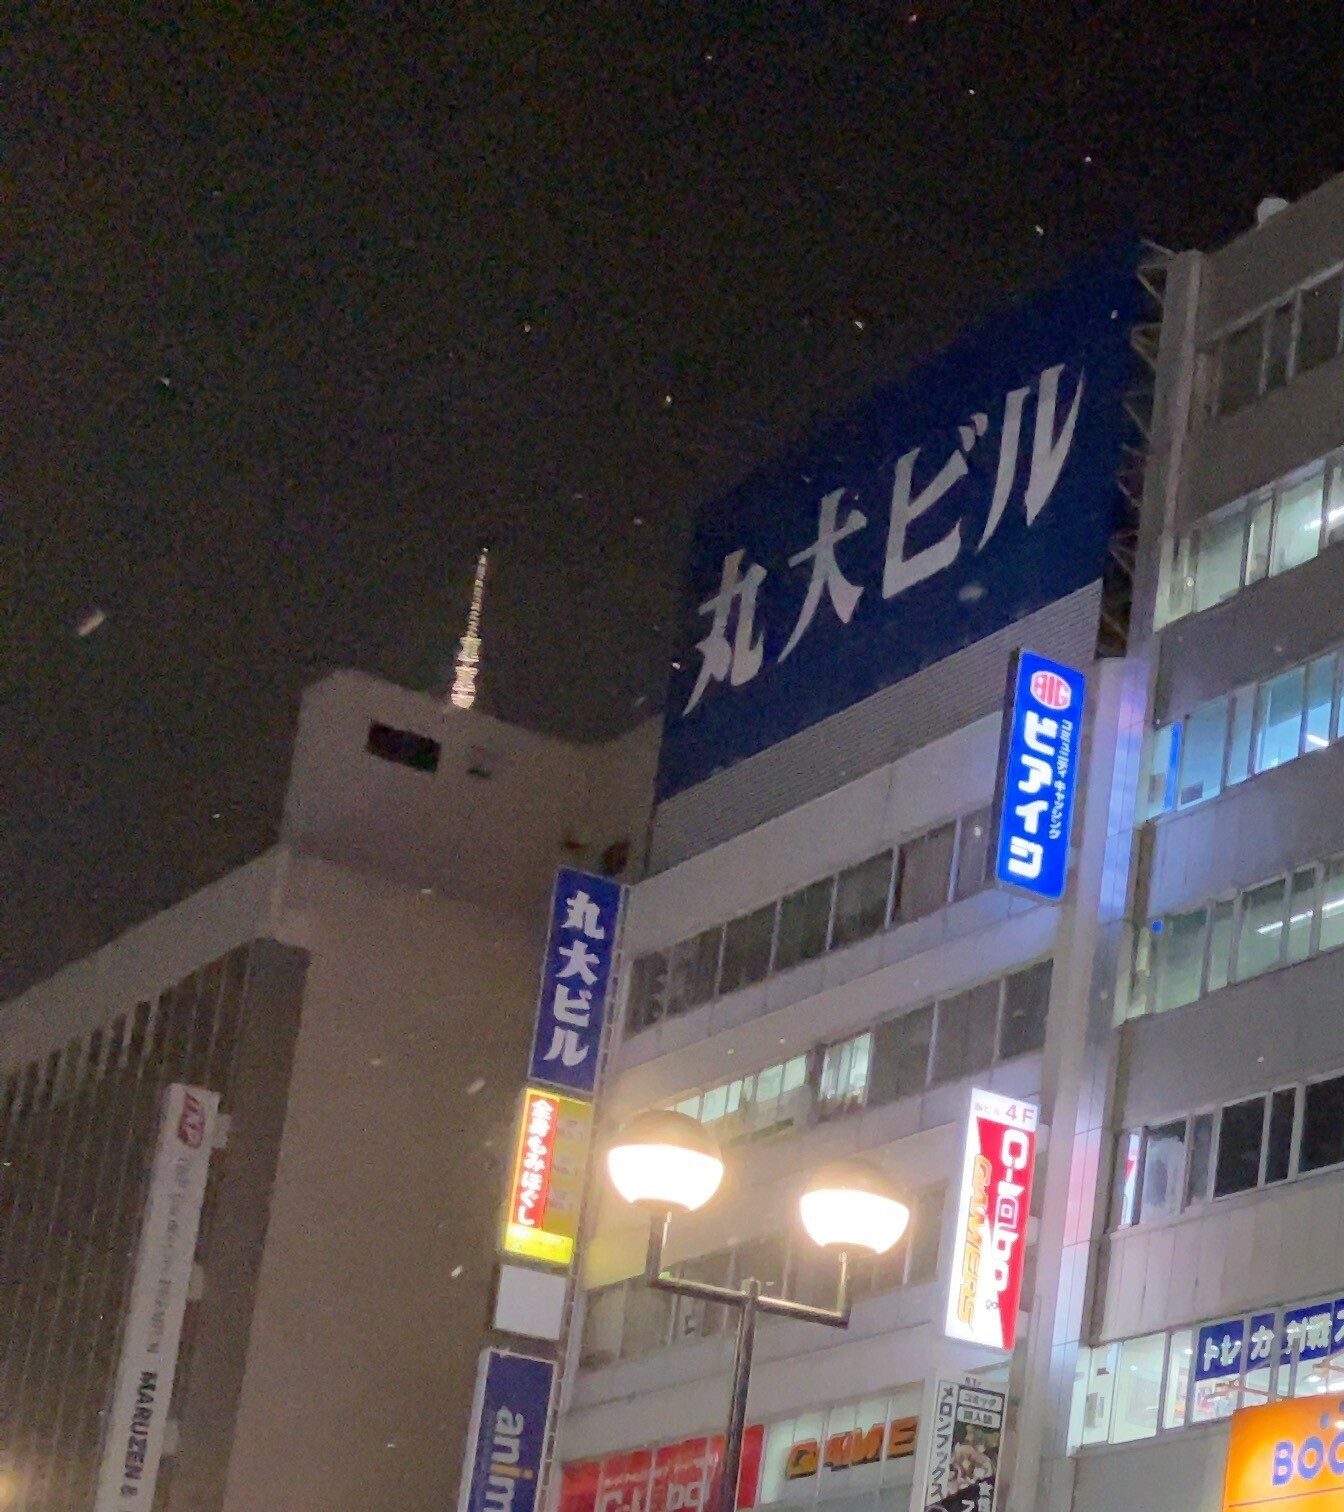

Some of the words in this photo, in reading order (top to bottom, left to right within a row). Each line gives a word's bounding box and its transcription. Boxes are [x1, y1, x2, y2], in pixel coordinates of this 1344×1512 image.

[682, 357, 1085, 716] 丸大ビル
[544, 892, 604, 1067] 丸大ビル
[1005, 1105, 1034, 1123] 4F
[957, 1153, 992, 1331] GAMERS
[931, 1387, 954, 1499] メロンブックス
